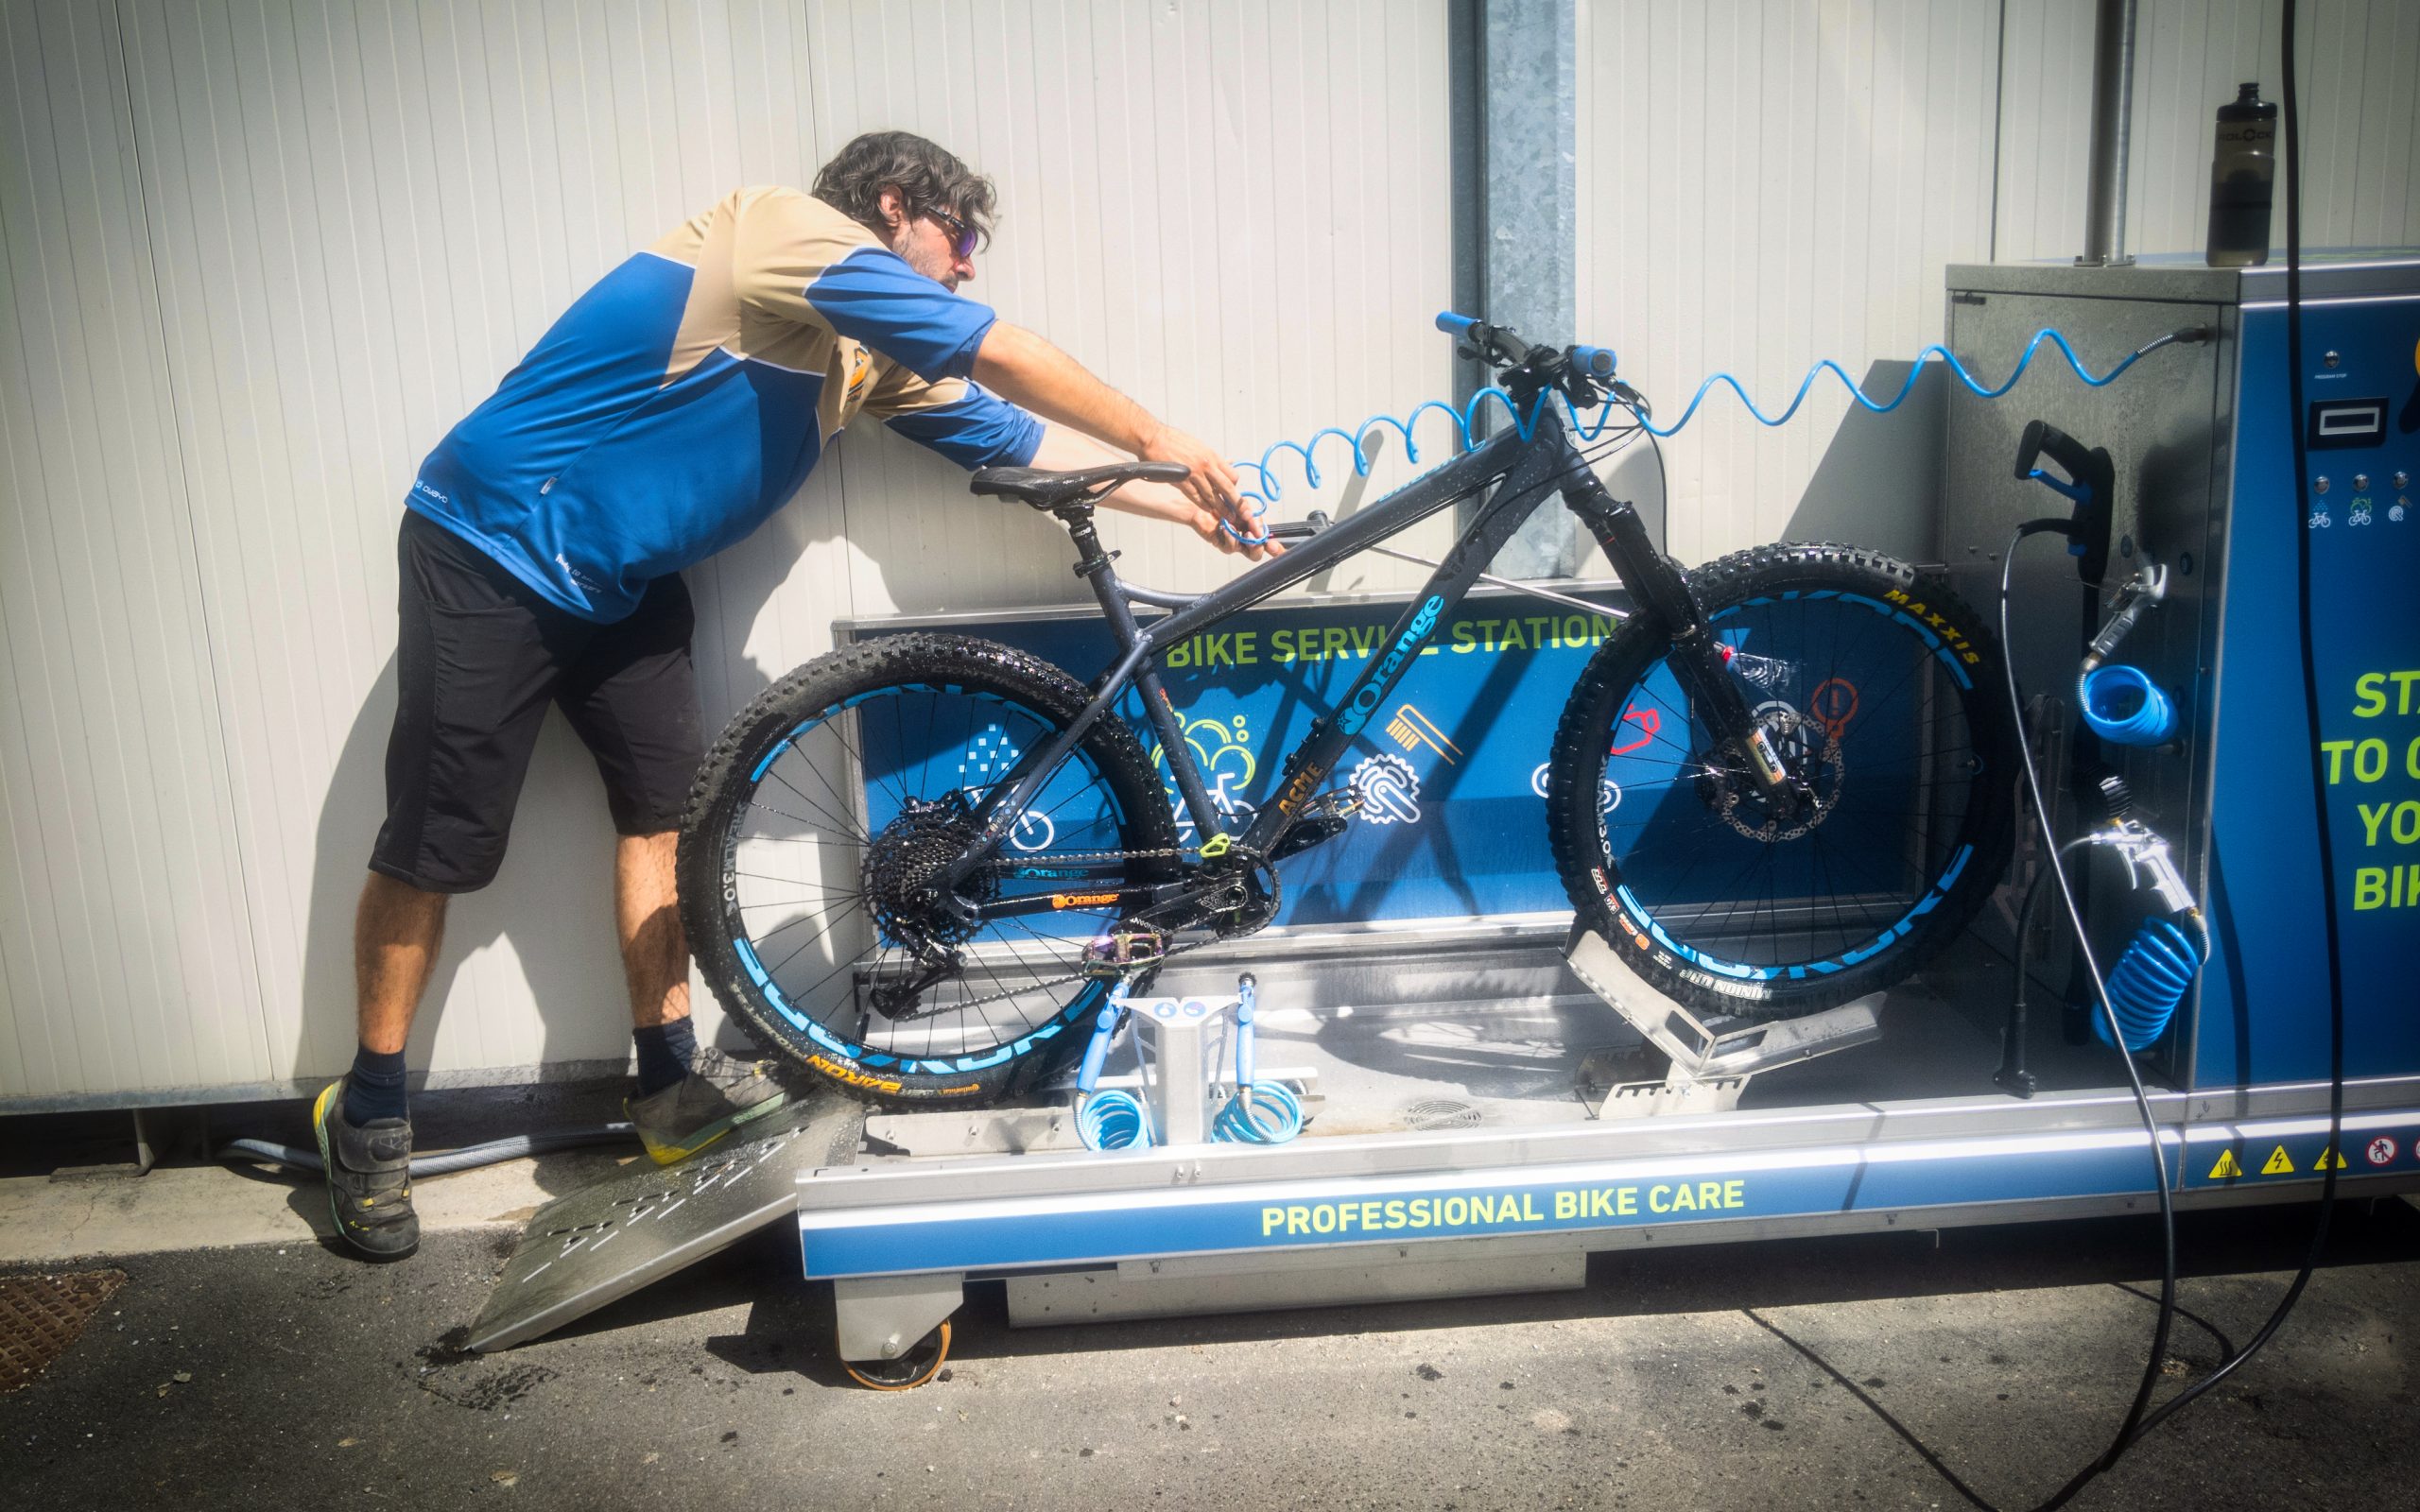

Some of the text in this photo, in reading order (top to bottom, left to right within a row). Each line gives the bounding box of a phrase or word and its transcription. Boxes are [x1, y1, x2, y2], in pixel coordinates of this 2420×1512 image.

[1167, 615, 1617, 668] BIKE SERVI STATION
[1883, 590, 1979, 663] MAXXIS
[1353, 595, 1444, 716] Orange
[2352, 670, 2420, 718] ST
[2321, 738, 2389, 785] TO
[1066, 893, 1119, 906] Orange
[805, 1055, 903, 1094] BARON
[1262, 1180, 1745, 1236] PROFESSIONAL BIKE CARE
